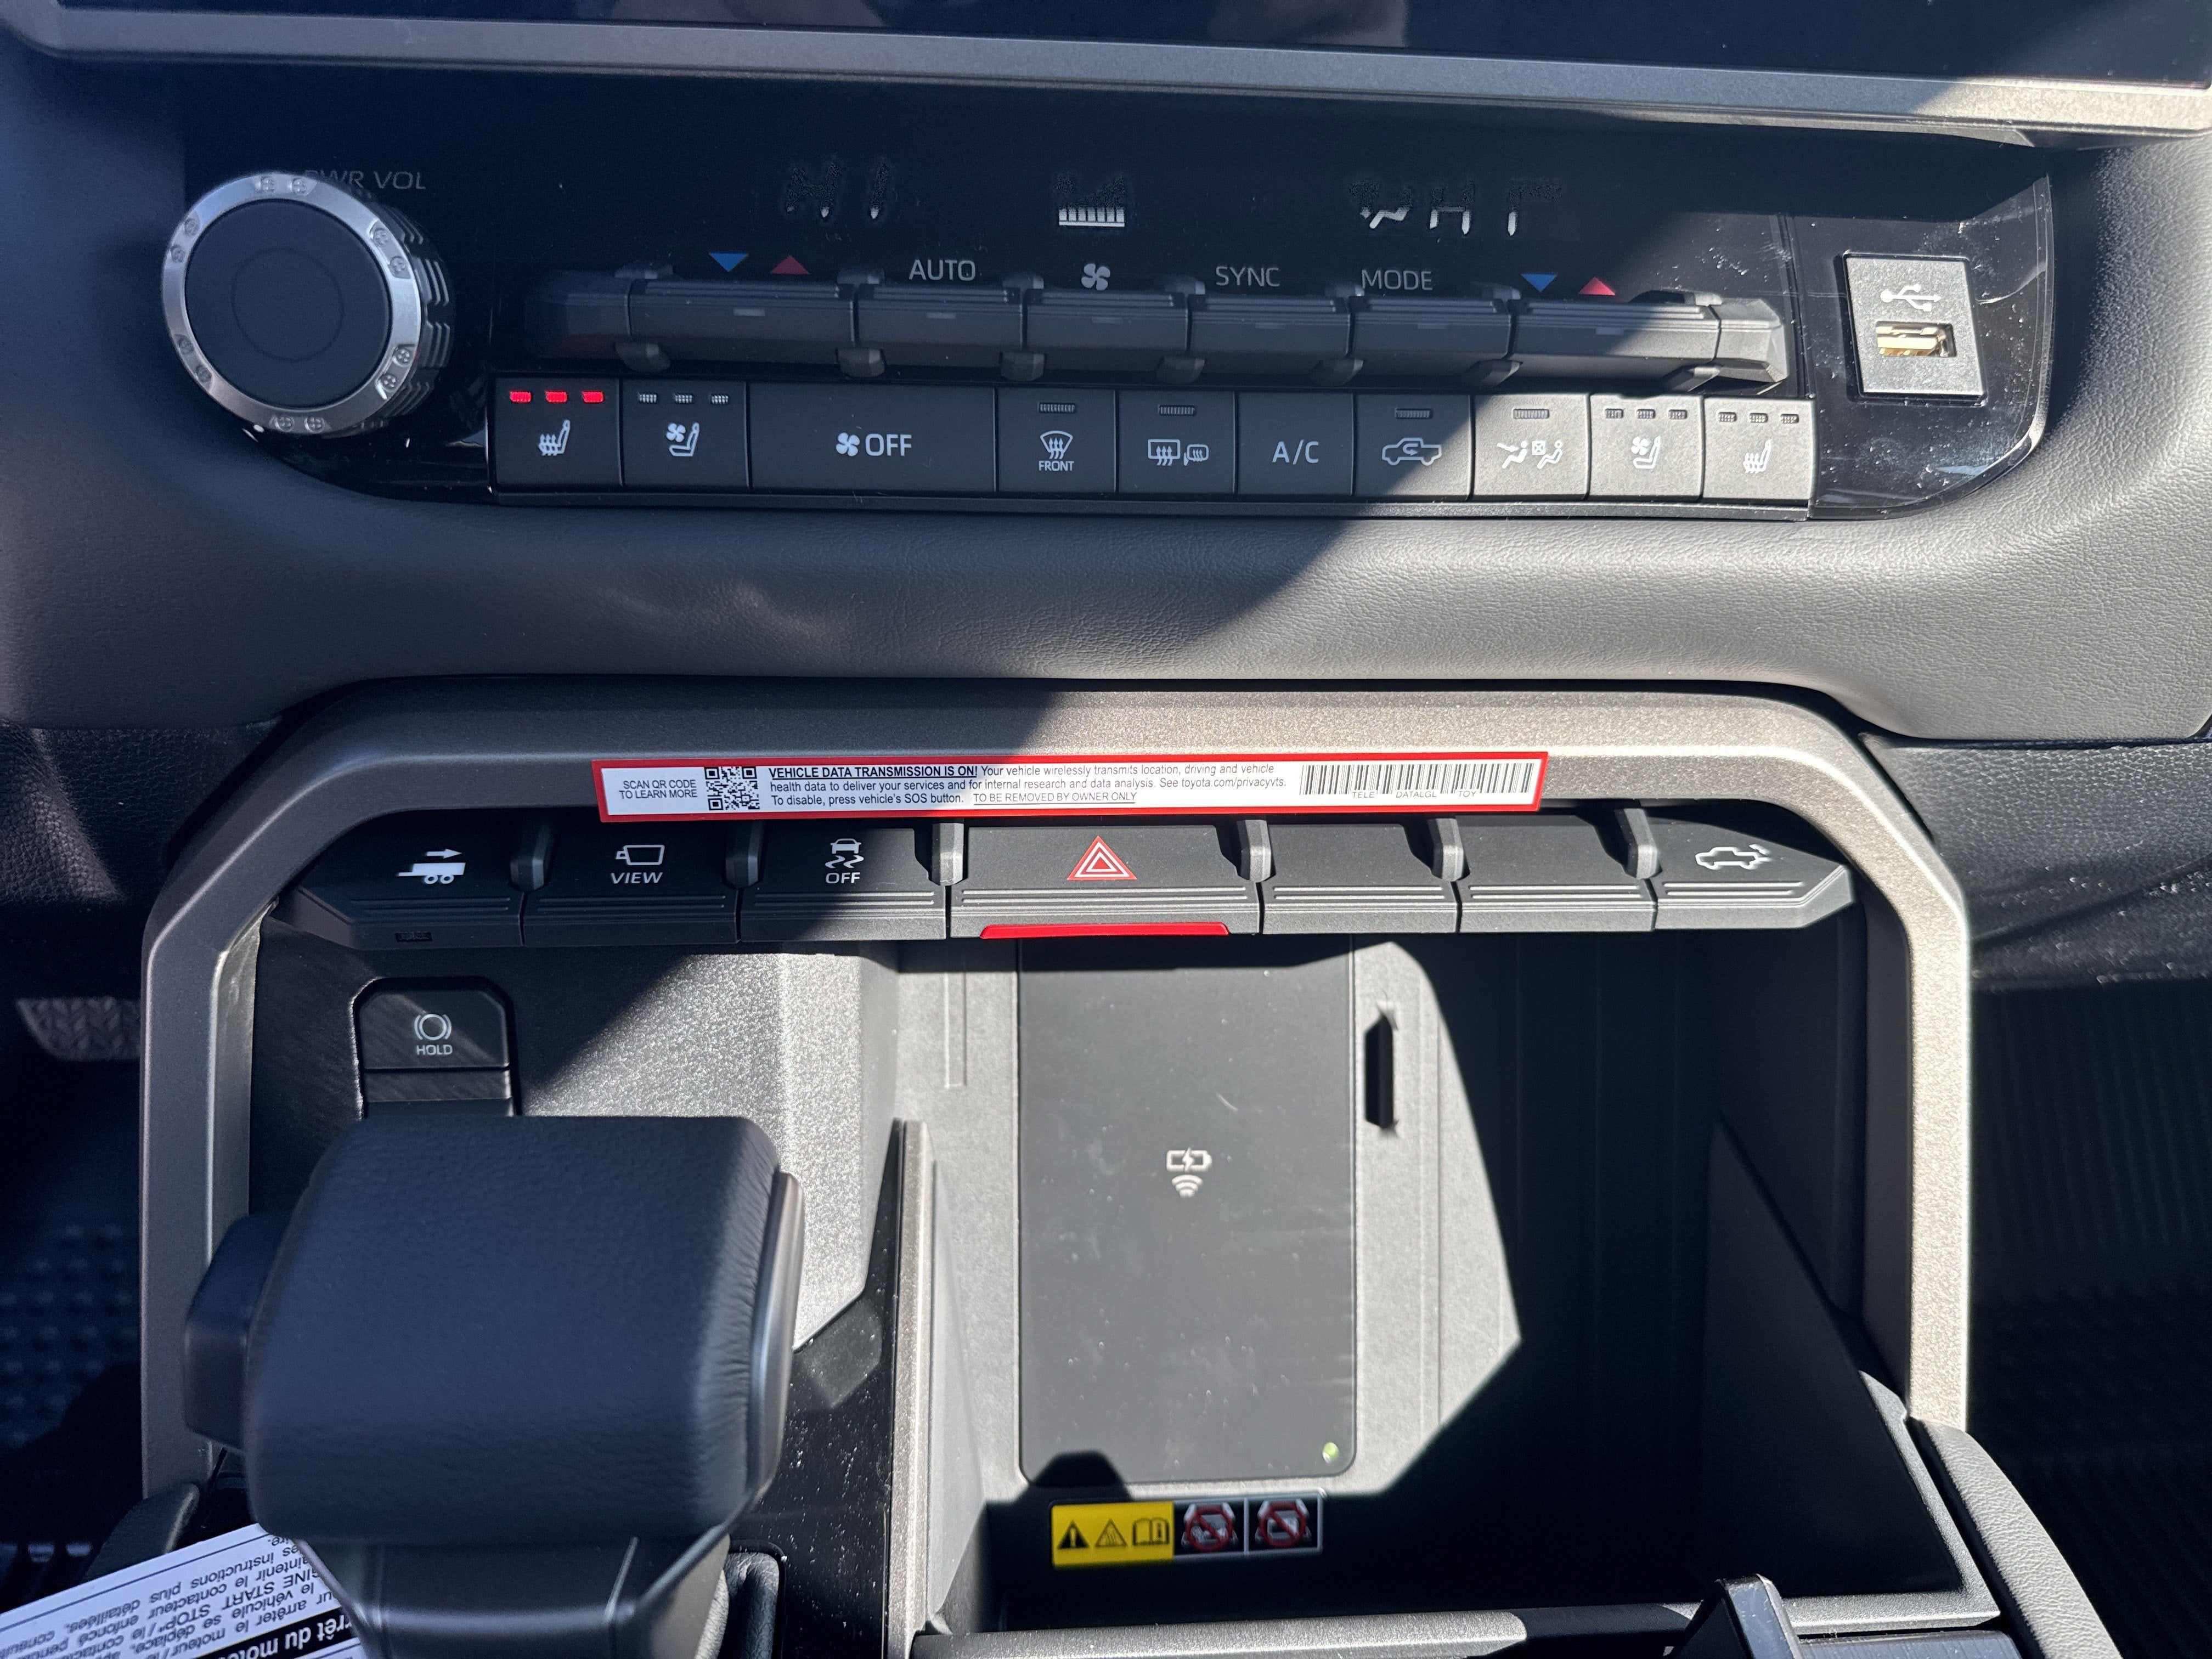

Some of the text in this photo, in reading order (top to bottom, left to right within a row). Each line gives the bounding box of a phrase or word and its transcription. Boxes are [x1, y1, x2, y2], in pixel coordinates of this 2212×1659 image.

[373, 171, 426, 190] VOL
[909, 259, 976, 281] AUTO
[1216, 266, 1280, 287] SYNC
[1361, 269, 1433, 291] MODE
[865, 433, 912, 456] OFF
[1272, 439, 1319, 465] A/C
[1039, 461, 1074, 472] FRONT
[769, 764, 1274, 778] VEHICLE DATA TRANSMISSION IS ON! Your vehicle wirelessly transmits location, driving and vehicle
[623, 779, 697, 789] SCAN QR CODE
[770, 781, 801, 792] health
[804, 781, 826, 791] data
[830, 782, 839, 791] to
[843, 781, 876, 791] deliver
[879, 782, 900, 793] your
[904, 780, 944, 791] services
[948, 780, 966, 789] and
[969, 780, 982, 789] for
[985, 779, 1020, 789] internal
[1024, 779, 1065, 789] research
[1070, 778, 1087, 788] and
[1091, 778, 1111, 788] data
[1160, 778, 1178, 788] See
[619, 789, 698, 799] TO LEARN MORE
[771, 792, 1137, 806] To disable, press vehicle's SOS button. TO BE REMOVED BY OWNER ONLY
[611, 872, 663, 884] VIEW
[826, 872, 861, 884] OFF
[416, 1044, 453, 1056] HOLD
[190, 1553, 274, 1589] instructions
[235, 1576, 248, 1587] le
[301, 1582, 314, 1594] le
[149, 1582, 181, 1603] plus
[221, 1582, 274, 1610] START
[316, 1590, 335, 1605] ur
[147, 1584, 227, 1620] contacteur
[232, 1590, 293, 1618] véhicule
[202, 1615, 222, 1628] se
[256, 1600, 307, 1626] arrêter
[235, 1620, 249, 1633] le
[317, 1615, 352, 1640] rrêt
[285, 1626, 312, 1650] du
